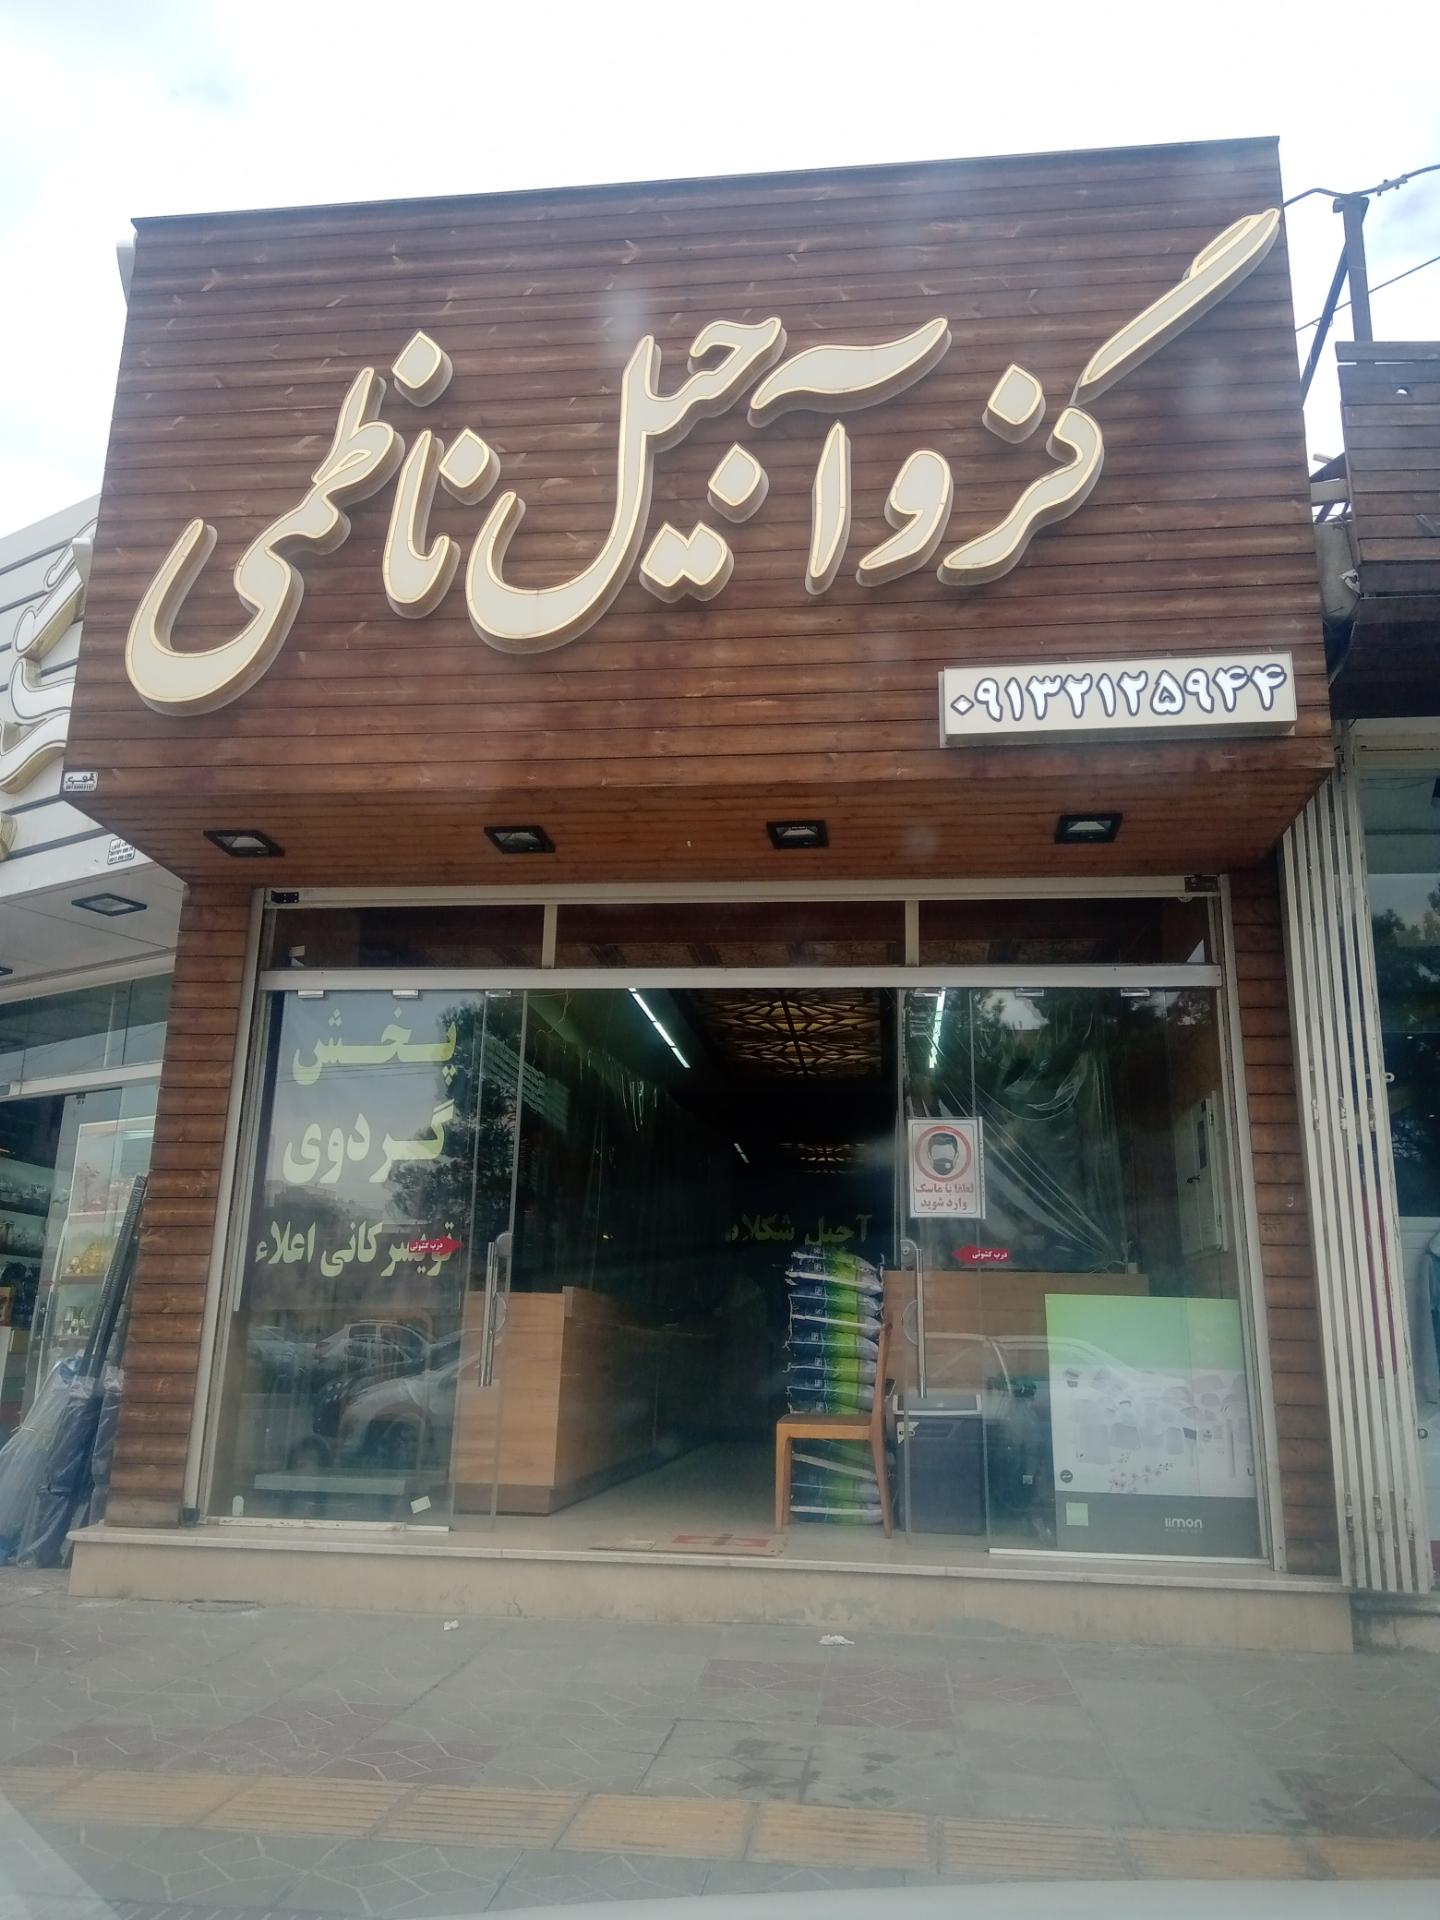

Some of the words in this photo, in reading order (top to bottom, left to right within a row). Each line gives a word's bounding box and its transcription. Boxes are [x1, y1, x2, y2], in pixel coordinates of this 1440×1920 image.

[941, 206, 1282, 573] گز
[467, 315, 948, 640] آجیل
[125, 330, 491, 703] ناظمی
[858, 449, 951, 573] و
[951, 662, 1287, 721] ۰۹۱۳۲۱۲۵۹۴۴
[293, 1006, 457, 1086] پخش
[283, 1099, 455, 1184] گردوی
[915, 1183, 943, 1194] ماسک
[920, 1197, 944, 1210] شوید
[944, 1183, 953, 1196] با
[946, 1197, 968, 1210] وارد
[954, 1183, 974, 1194] لطفا
[255, 1220, 317, 1265] اعلاء
[993, 1249, 1008, 1259] درب
[1164, 1518, 1203, 1529] limon
